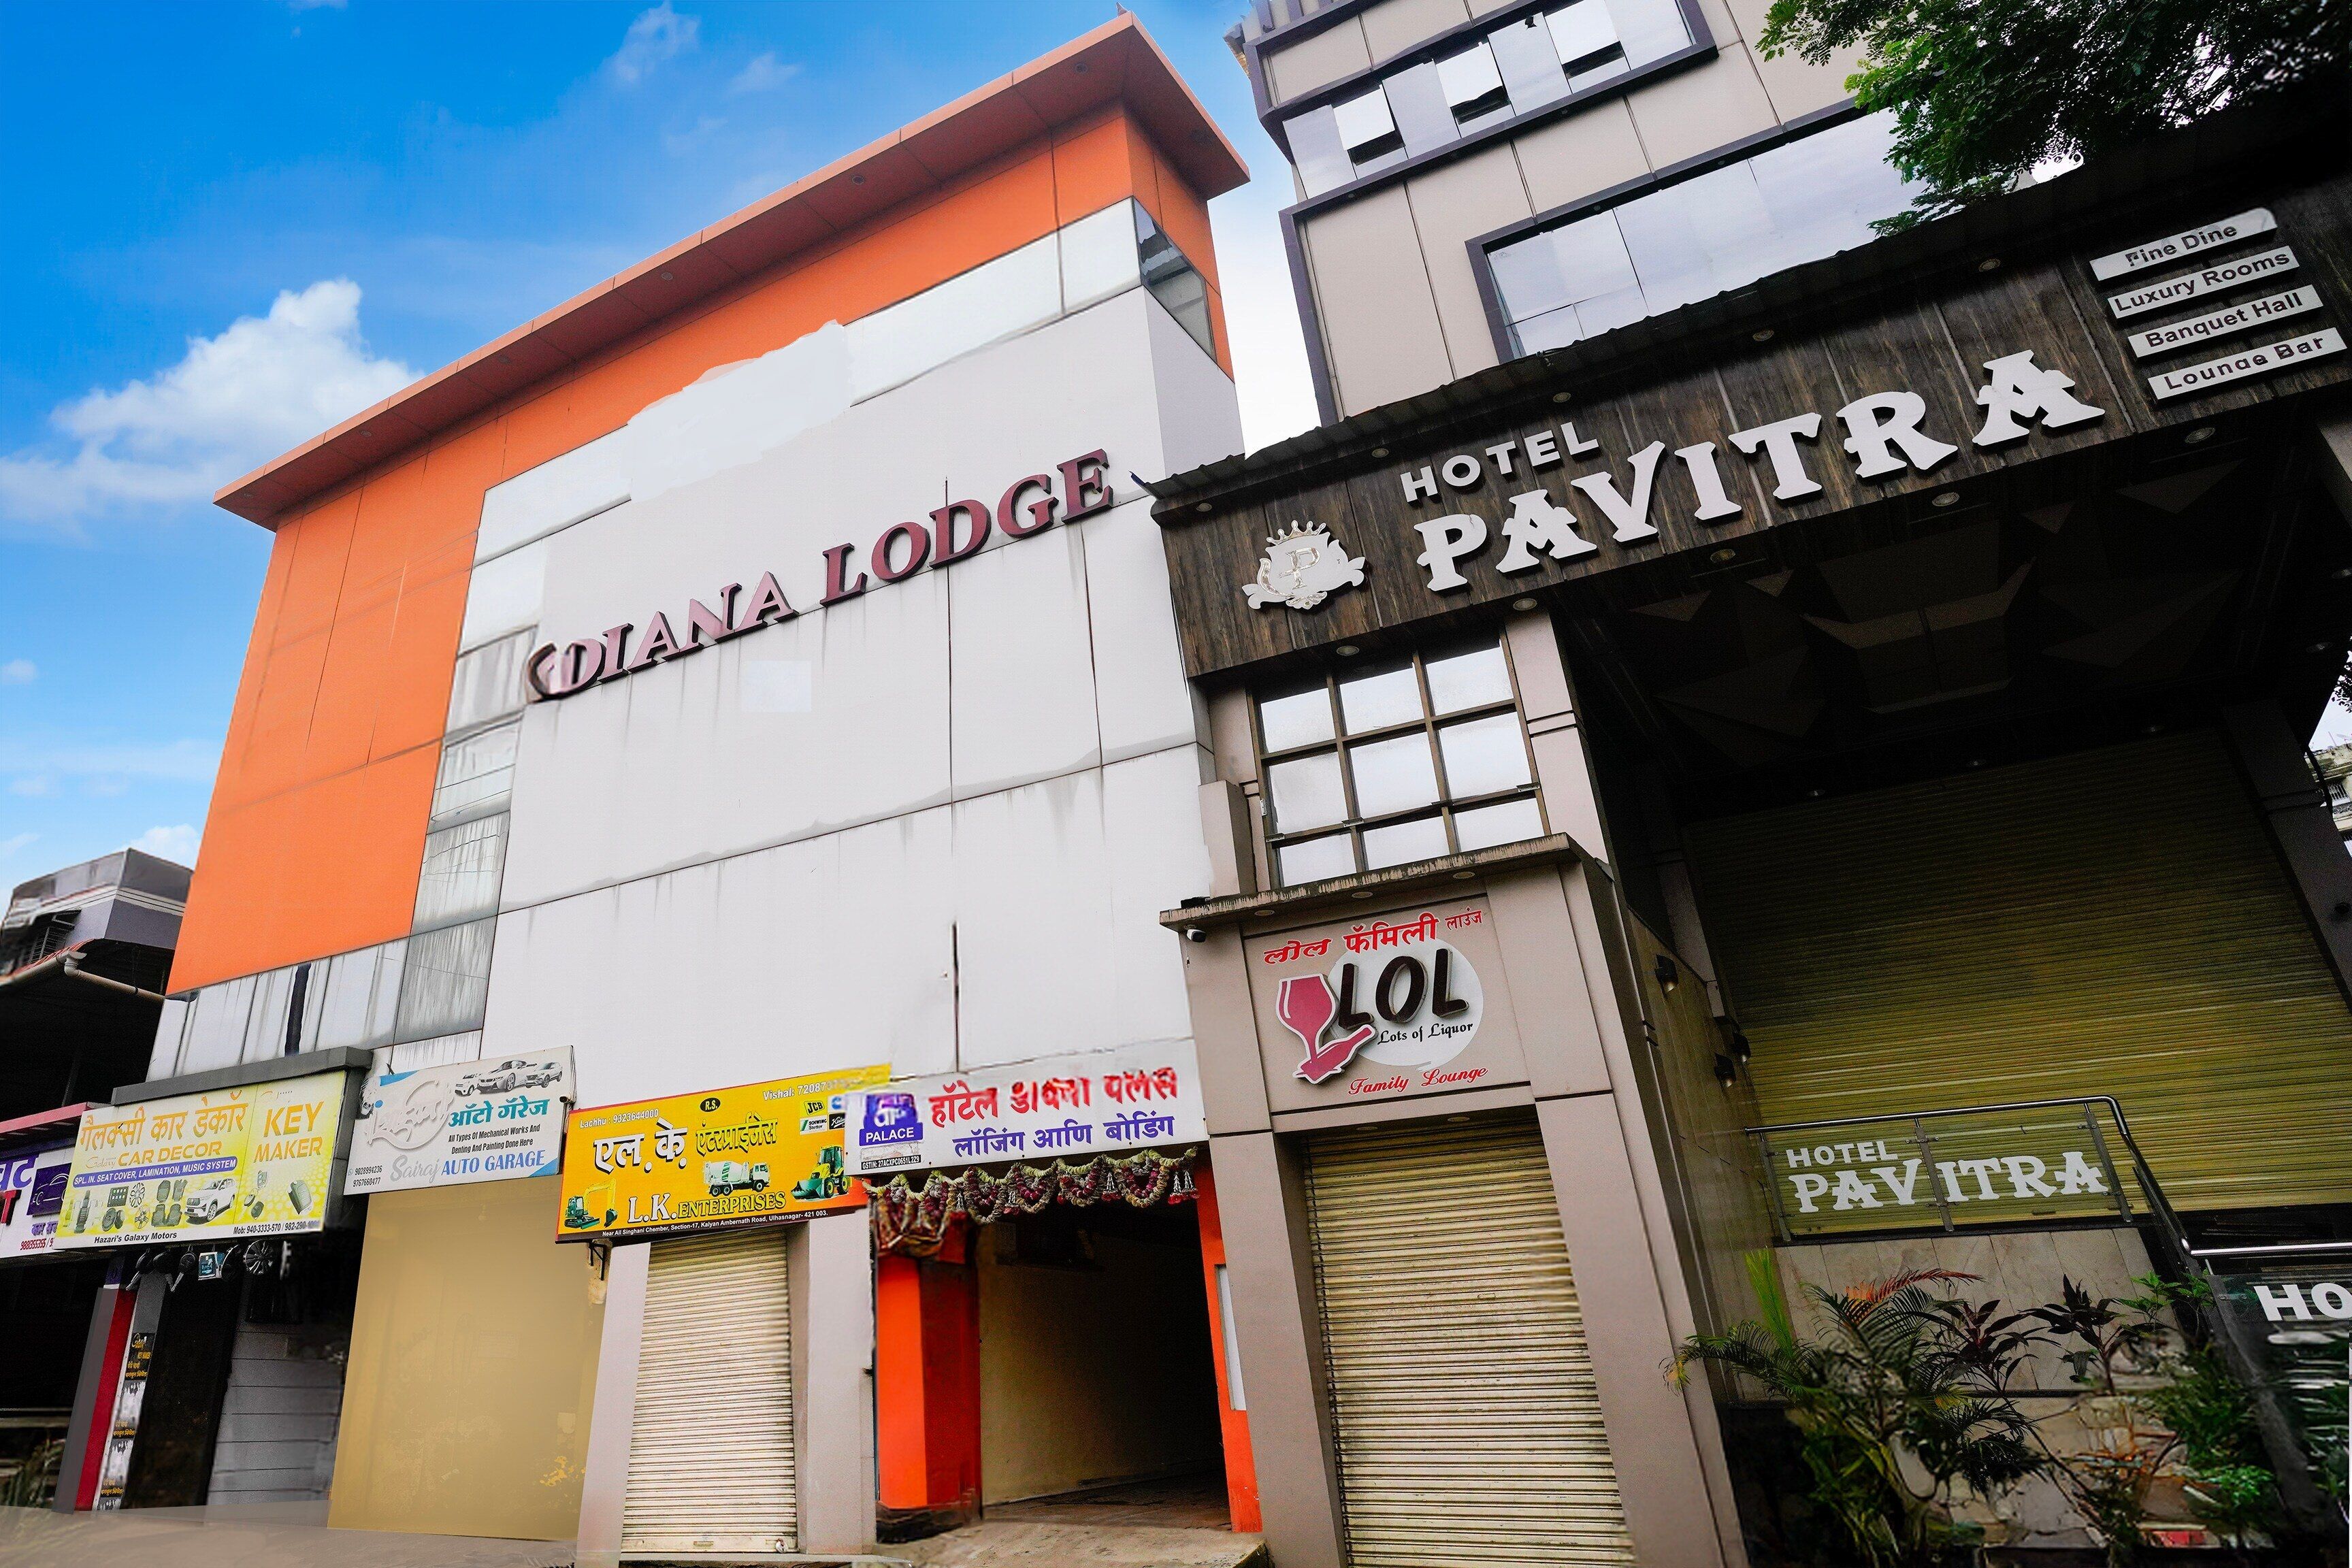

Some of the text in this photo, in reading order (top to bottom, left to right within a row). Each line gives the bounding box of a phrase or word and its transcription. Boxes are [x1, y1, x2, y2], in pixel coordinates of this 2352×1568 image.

[2125, 226, 2238, 267] Fine Dine
[2114, 252, 2291, 312] Luxury Rooms
[2145, 291, 2303, 348] Banquet Hall
[2273, 336, 2324, 360] Bar
[1400, 421, 1601, 504] HOTEL
[1414, 349, 2106, 591] PAVITRA
[819, 448, 1115, 608] LODGE
[1264, 938, 1333, 965] लोल
[1337, 948, 1469, 1030] LOL
[1377, 1022, 1474, 1045] Lots of Liquor
[763, 1087, 794, 1100] Vishal:
[1348, 1066, 1489, 1095] Family Lounge
[263, 1100, 325, 1137] KEY
[448, 1100, 493, 1127] ऑटो
[580, 1117, 606, 1128] Lachhu
[612, 1109, 659, 1124] 9323644000
[705, 1100, 718, 1111] R.S.
[807, 1102, 823, 1114] JCB
[150, 1111, 189, 1141] कार
[456, 1133, 472, 1143] Types
[472, 1132, 478, 1140] Of
[478, 1128, 509, 1139] Mechanical
[510, 1125, 529, 1134] Works
[529, 1124, 540, 1132] And
[866, 1127, 915, 1143] PALACE
[952, 1127, 1026, 1158] लॉजिंग
[1033, 1118, 1093, 1148] आणि
[118, 1148, 156, 1166] CAR
[157, 1141, 223, 1161] DECOR
[253, 1136, 323, 1163] MAKER
[451, 1137, 534, 1154] Denting And Painting Done Here
[1786, 1140, 1899, 1169] HOTEL
[74, 1158, 236, 1185] SPL. IN. SEAT COVER, LAMINATION, MUSIC SYSTEM
[390, 1150, 546, 1183] Sairaj AUTO GARAGE
[1788, 1151, 2109, 1213] PAVITRA
[627, 1191, 787, 1224] L.K. ENTERPRISES
[94, 1232, 177, 1243] Hazari's Galaxy Motors
[233, 1226, 246, 1235] Mob:
[246, 1223, 281, 1233] 940-3333-570
